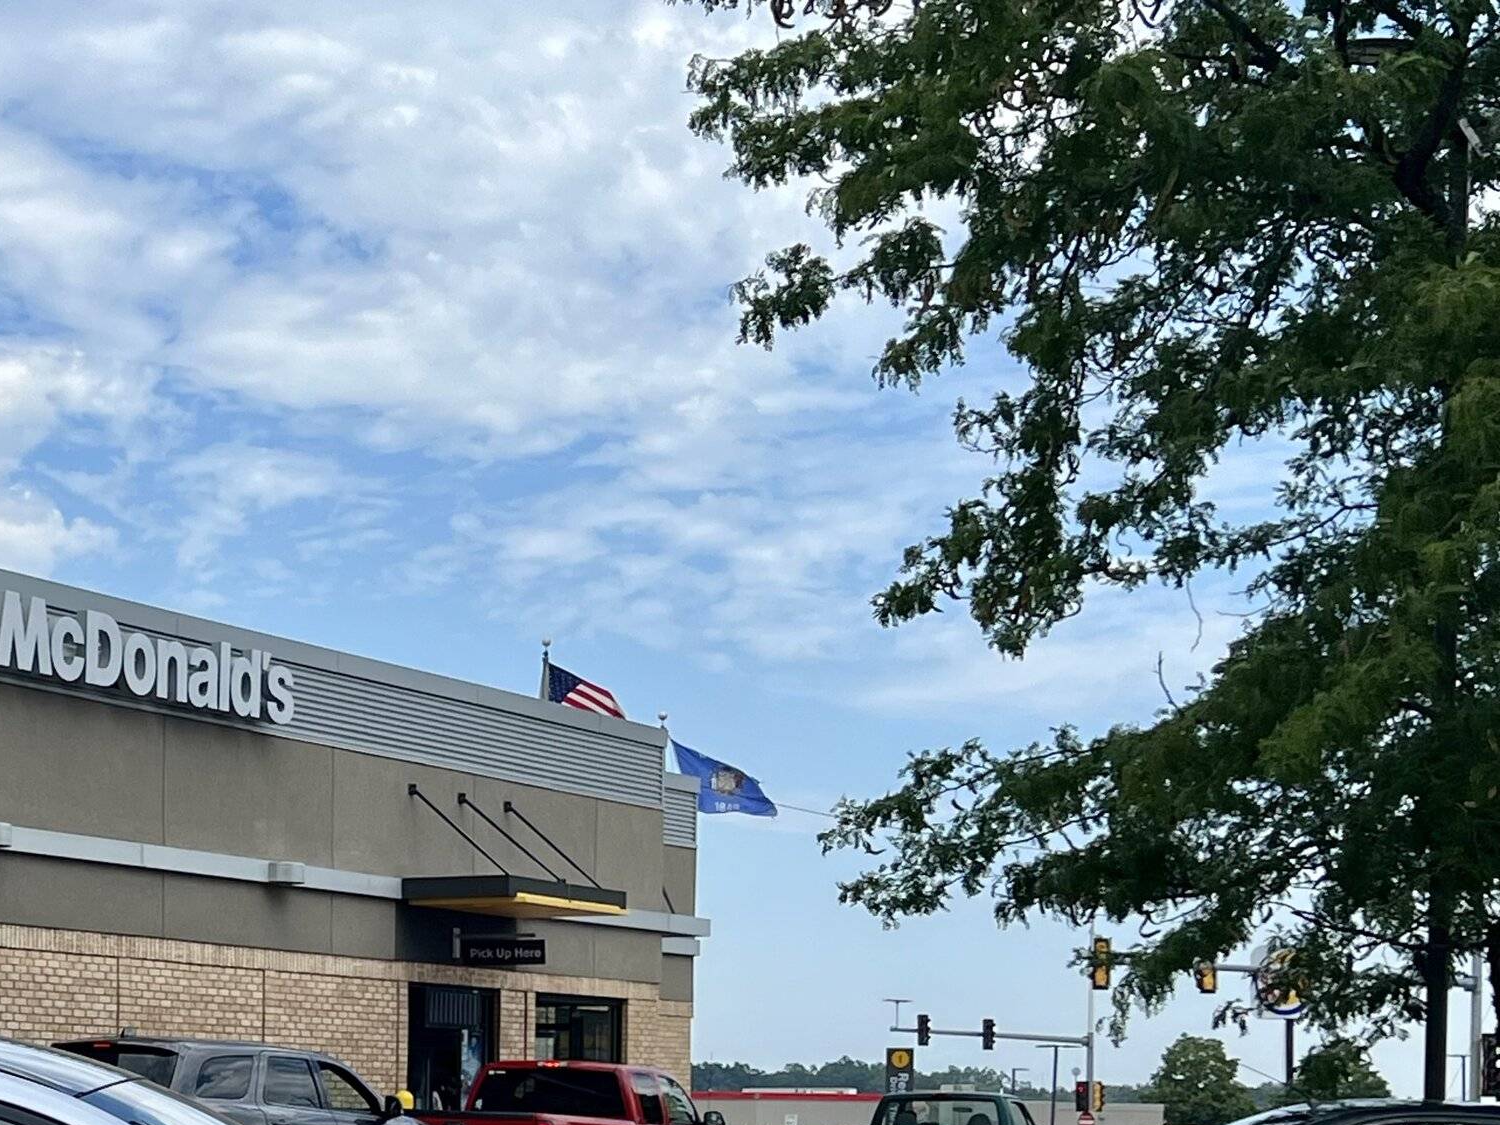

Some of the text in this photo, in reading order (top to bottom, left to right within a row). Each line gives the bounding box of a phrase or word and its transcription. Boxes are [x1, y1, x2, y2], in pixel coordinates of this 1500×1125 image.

[469, 946, 542, 960] Pick Up Here
